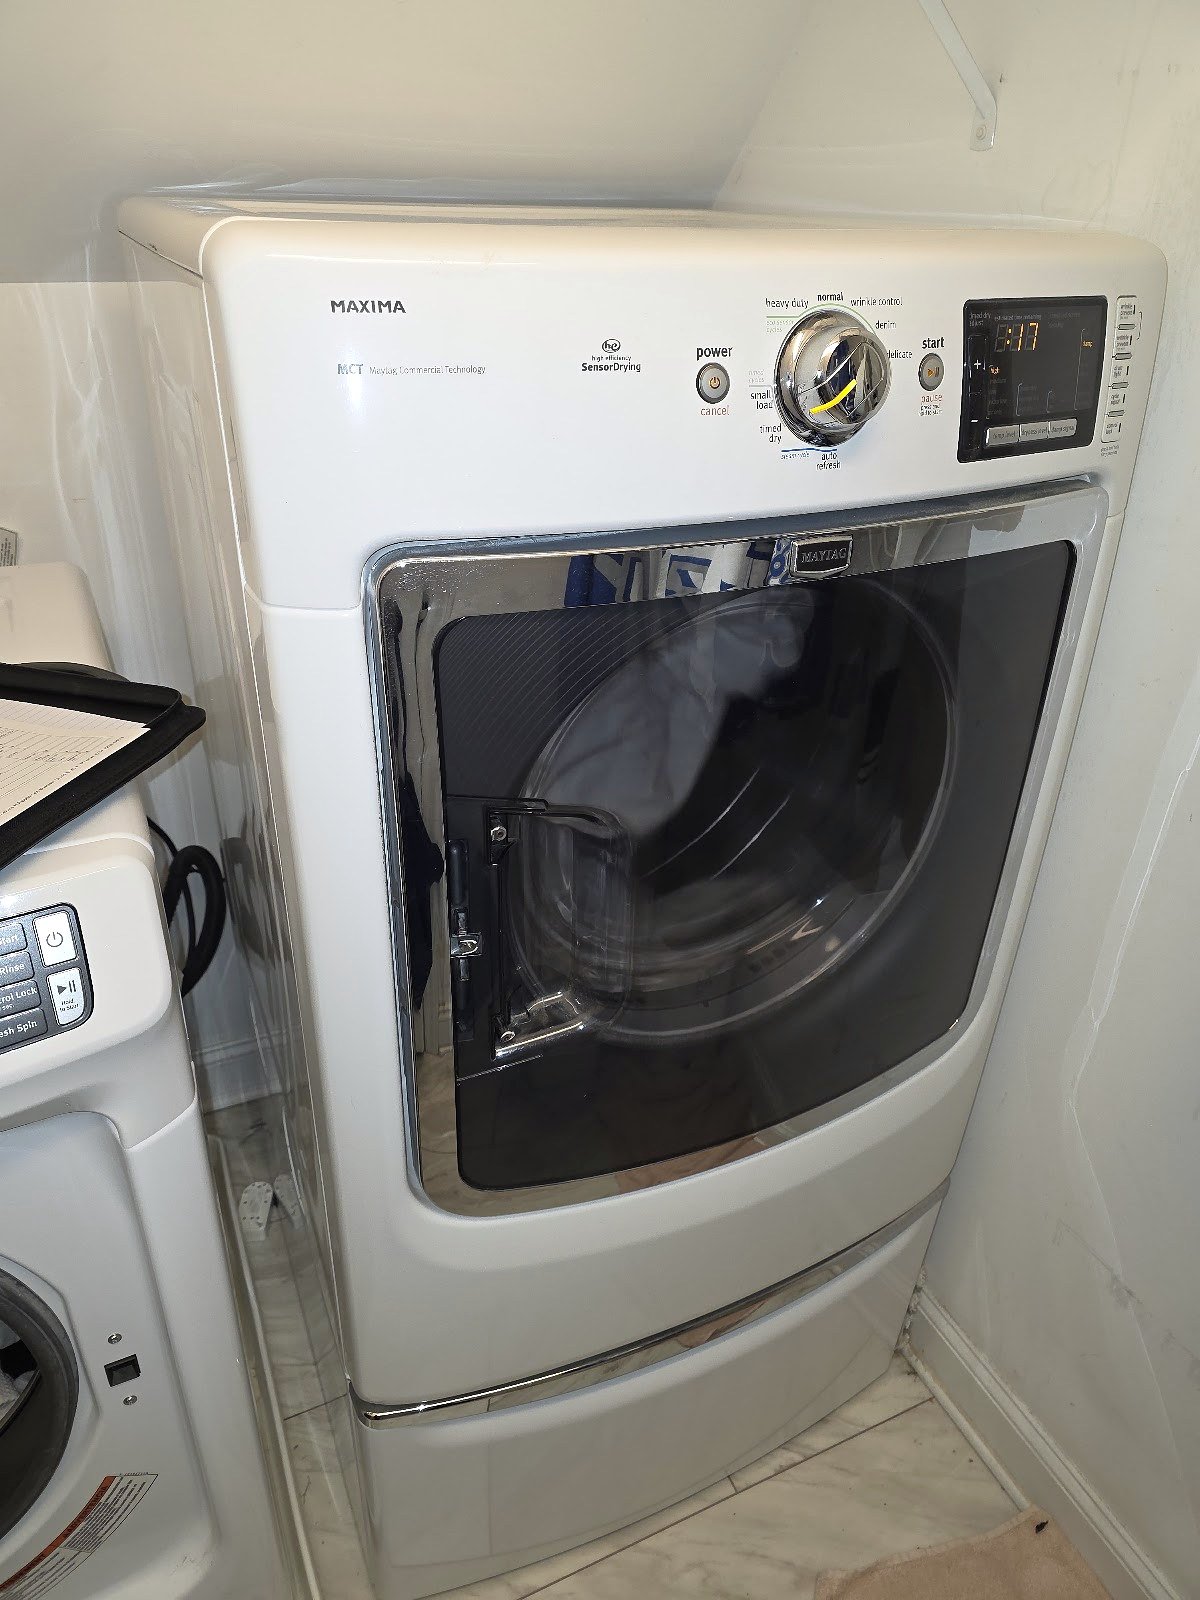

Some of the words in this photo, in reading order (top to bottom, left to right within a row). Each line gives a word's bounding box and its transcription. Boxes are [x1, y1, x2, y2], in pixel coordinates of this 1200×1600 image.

[817, 291, 844, 301] normal
[330, 300, 407, 313] MAXIMA
[765, 298, 789, 309] heavy
[791, 298, 809, 309] duty
[850, 297, 877, 307] wrinkle
[879, 297, 903, 306] control
[875, 319, 897, 330] denim
[921, 337, 945, 349] start
[696, 346, 733, 362] power
[887, 350, 912, 359] delicate
[337, 363, 364, 375] MCT
[399, 365, 443, 375] Commercial
[444, 364, 487, 375] Technology
[581, 362, 641, 373] SensorDrying
[750, 389, 772, 400] small
[700, 405, 731, 416] cancel
[760, 423, 782, 434] timed
[769, 433, 782, 445] dry
[821, 452, 838, 461] auto
[816, 460, 841, 471] refresh
[801, 547, 847, 563] MAYTAG
[16, 986, 38, 999] Lock
[17, 1021, 38, 1033] Spin
